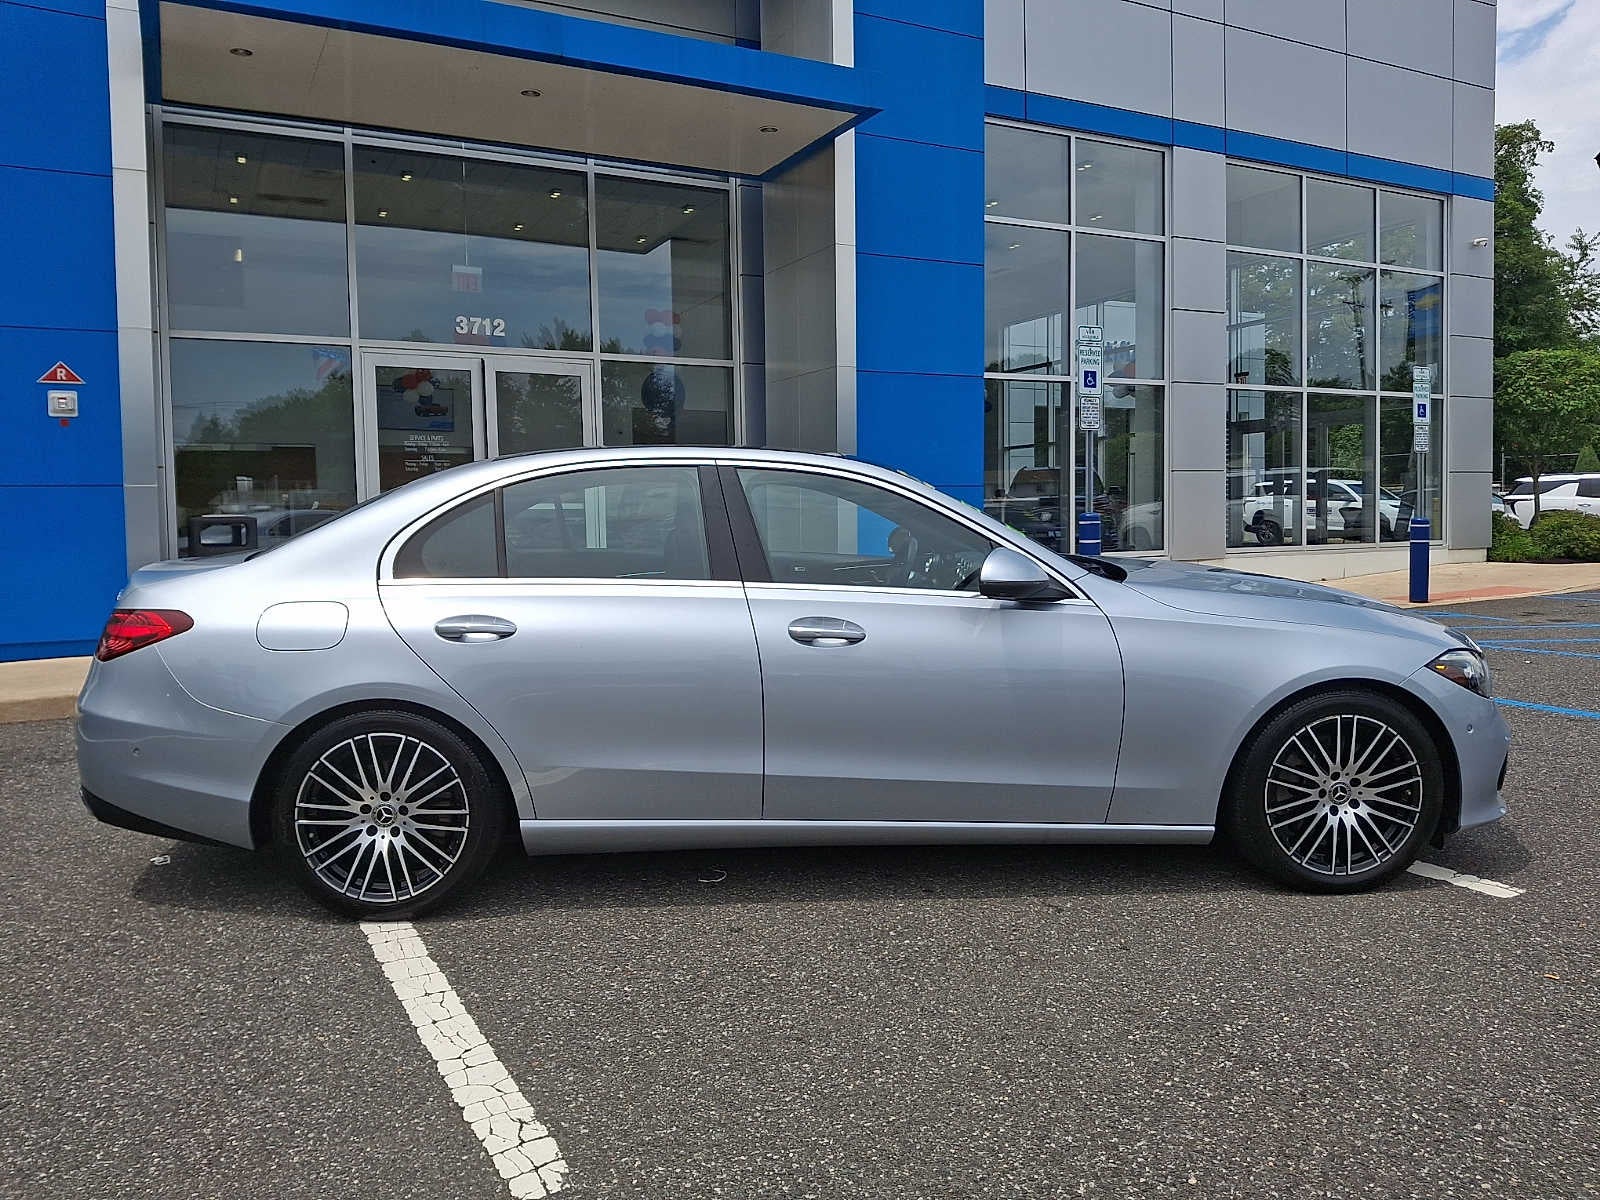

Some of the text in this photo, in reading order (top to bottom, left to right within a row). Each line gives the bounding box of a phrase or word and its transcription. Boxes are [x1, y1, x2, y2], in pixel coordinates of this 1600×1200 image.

[455, 315, 505, 337] 3712
[1080, 357, 1100, 366] PARKING
[56, 368, 66, 381] R
